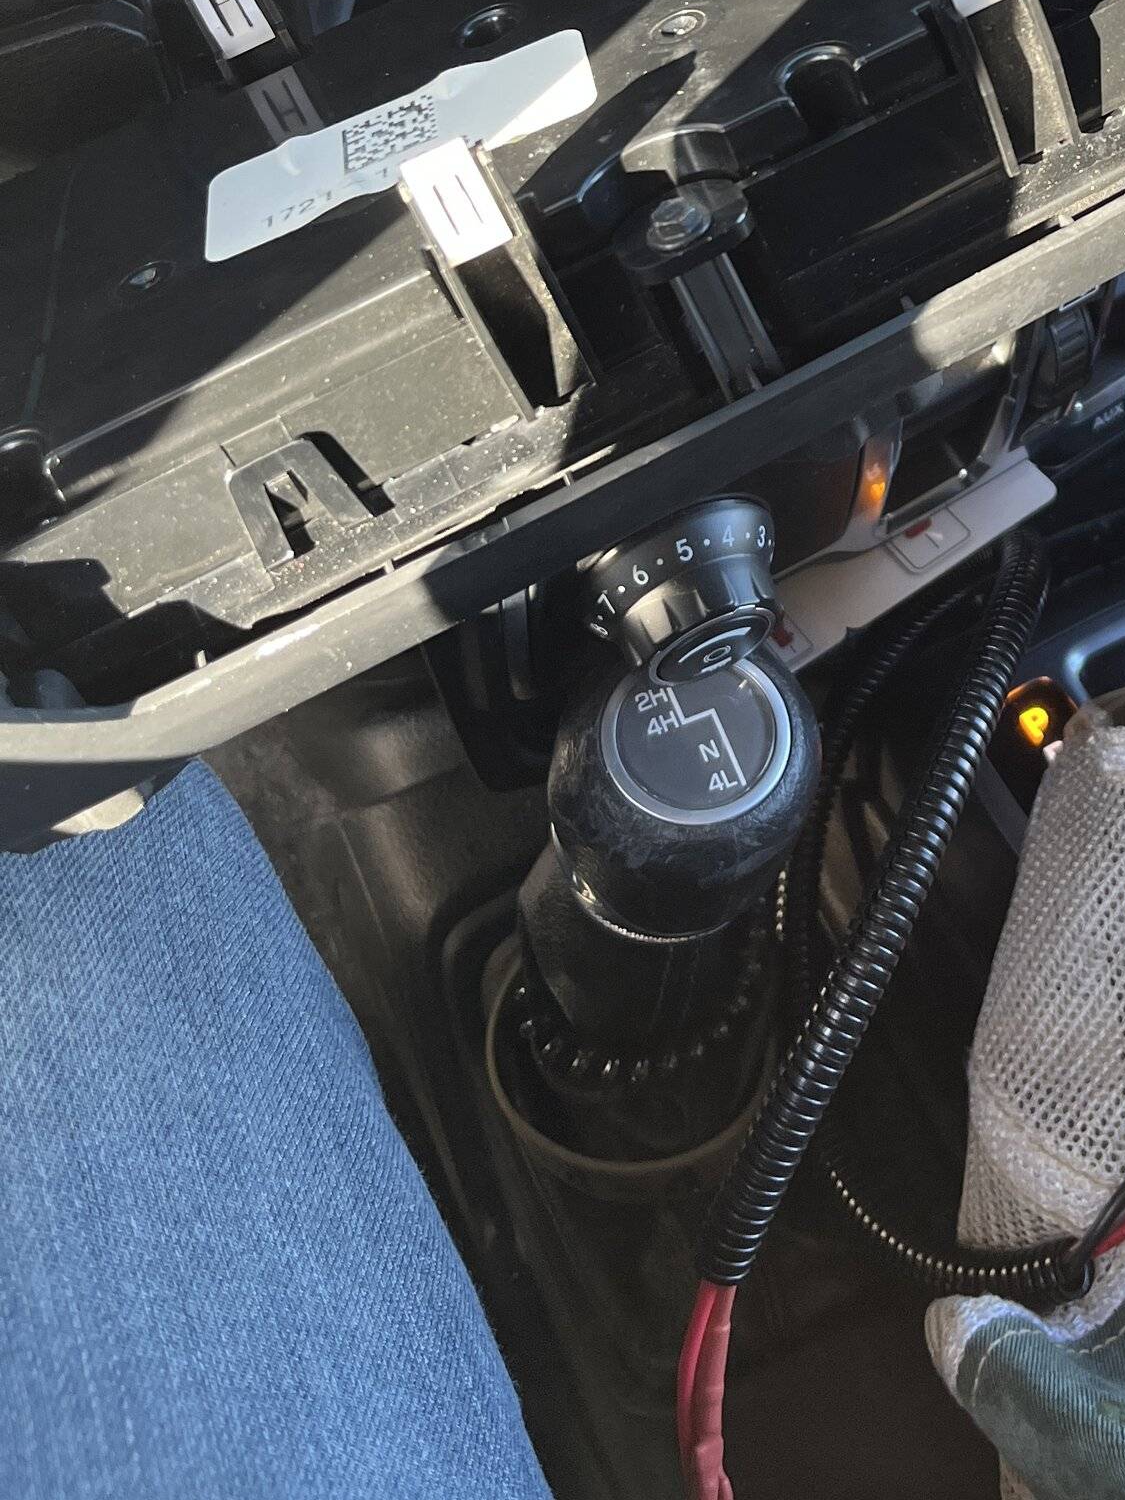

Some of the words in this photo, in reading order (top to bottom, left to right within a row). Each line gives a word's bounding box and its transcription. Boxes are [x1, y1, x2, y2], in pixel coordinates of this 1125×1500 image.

[1093, 403, 1124, 429] AUX
[597, 589, 616, 615] 7
[632, 564, 650, 586] 6
[675, 538, 694, 562] 5
[721, 524, 735, 548] 4
[757, 525, 767, 548] 3
[633, 688, 669, 714] 2H
[646, 709, 681, 738] 4H
[1018, 706, 1049, 746] P
[698, 739, 721, 764] N
[707, 769, 738, 794] 4L
